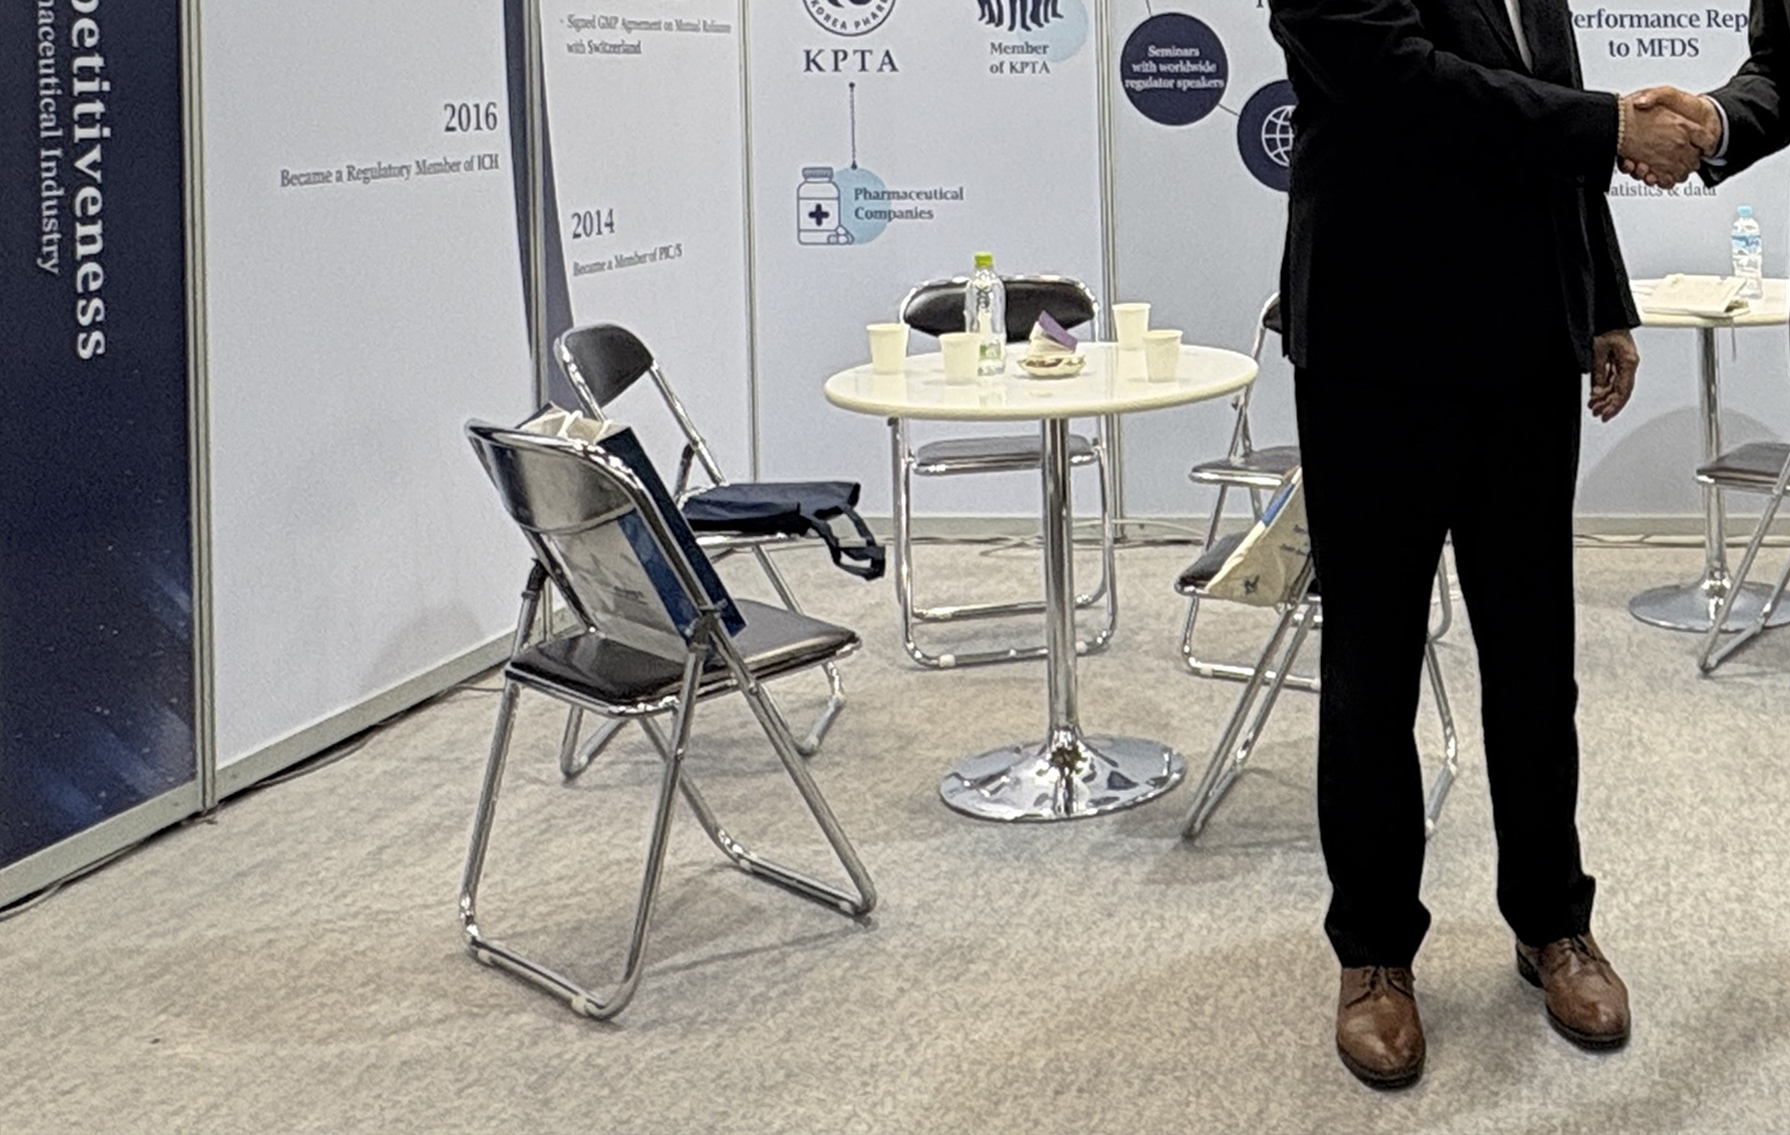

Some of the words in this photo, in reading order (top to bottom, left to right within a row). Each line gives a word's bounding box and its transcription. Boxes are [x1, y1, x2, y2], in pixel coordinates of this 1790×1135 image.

[1573, 8, 1701, 29] erformance
[989, 41, 1050, 57] Member
[1147, 44, 1200, 58] Seminars
[1608, 38, 1631, 58] to
[1635, 37, 1700, 58] MFDS
[803, 48, 900, 73] KPTA
[989, 61, 1004, 75] of
[1008, 62, 1051, 75] KPTA
[1132, 60, 1157, 74] with
[1159, 59, 1217, 74] worldwide
[1124, 76, 1175, 91] regulator
[1176, 76, 1225, 91] speakers
[443, 101, 499, 133] 2016
[279, 167, 332, 188] Became
[335, 171, 343, 184] a
[346, 160, 412, 185] Regulatory
[414, 156, 461, 176] Member
[476, 153, 500, 170] ICH
[853, 186, 965, 202] Pharmaceutical
[1610, 182, 1664, 197] atistics
[36, 147, 65, 275] Industry
[854, 205, 935, 221] Companies
[571, 207, 616, 239] 2014
